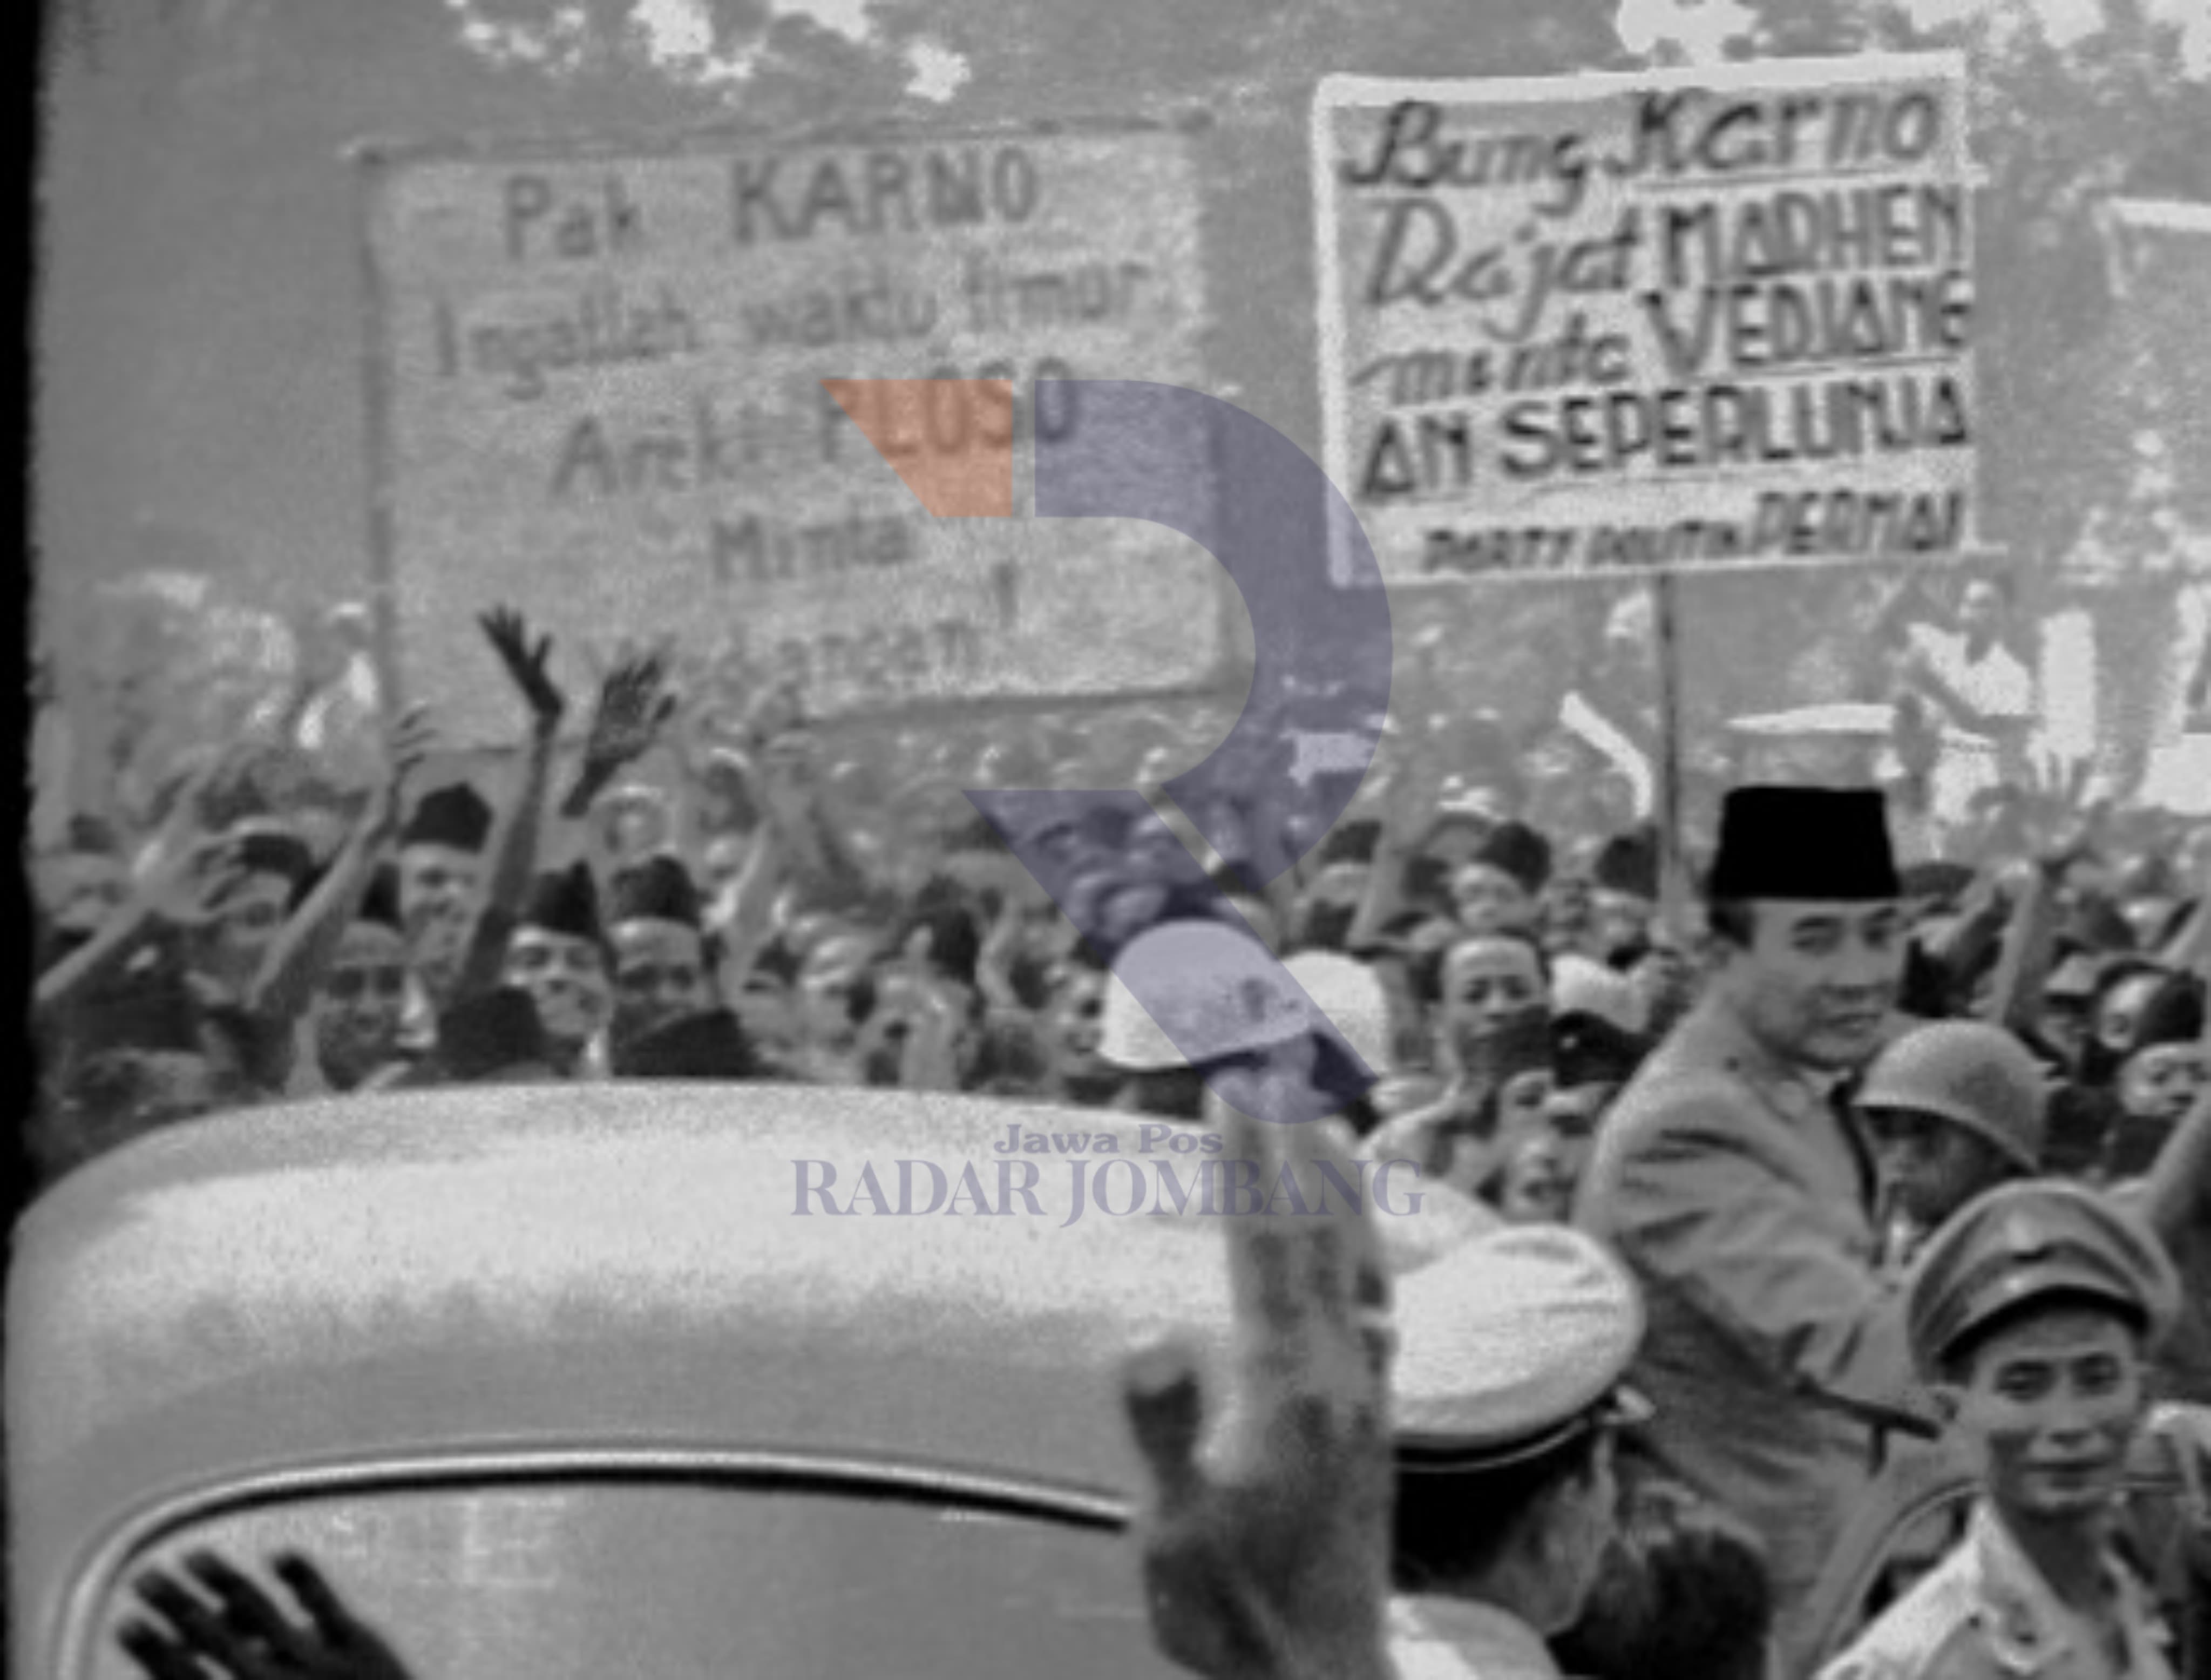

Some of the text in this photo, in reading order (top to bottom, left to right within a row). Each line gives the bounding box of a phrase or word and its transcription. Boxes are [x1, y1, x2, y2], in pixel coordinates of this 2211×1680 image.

[504, 145, 1041, 258] Pak KARNO
[1337, 86, 1940, 215] Bung Karno
[815, 356, 1081, 464] PLOSO
[1360, 414, 1473, 503] AN
